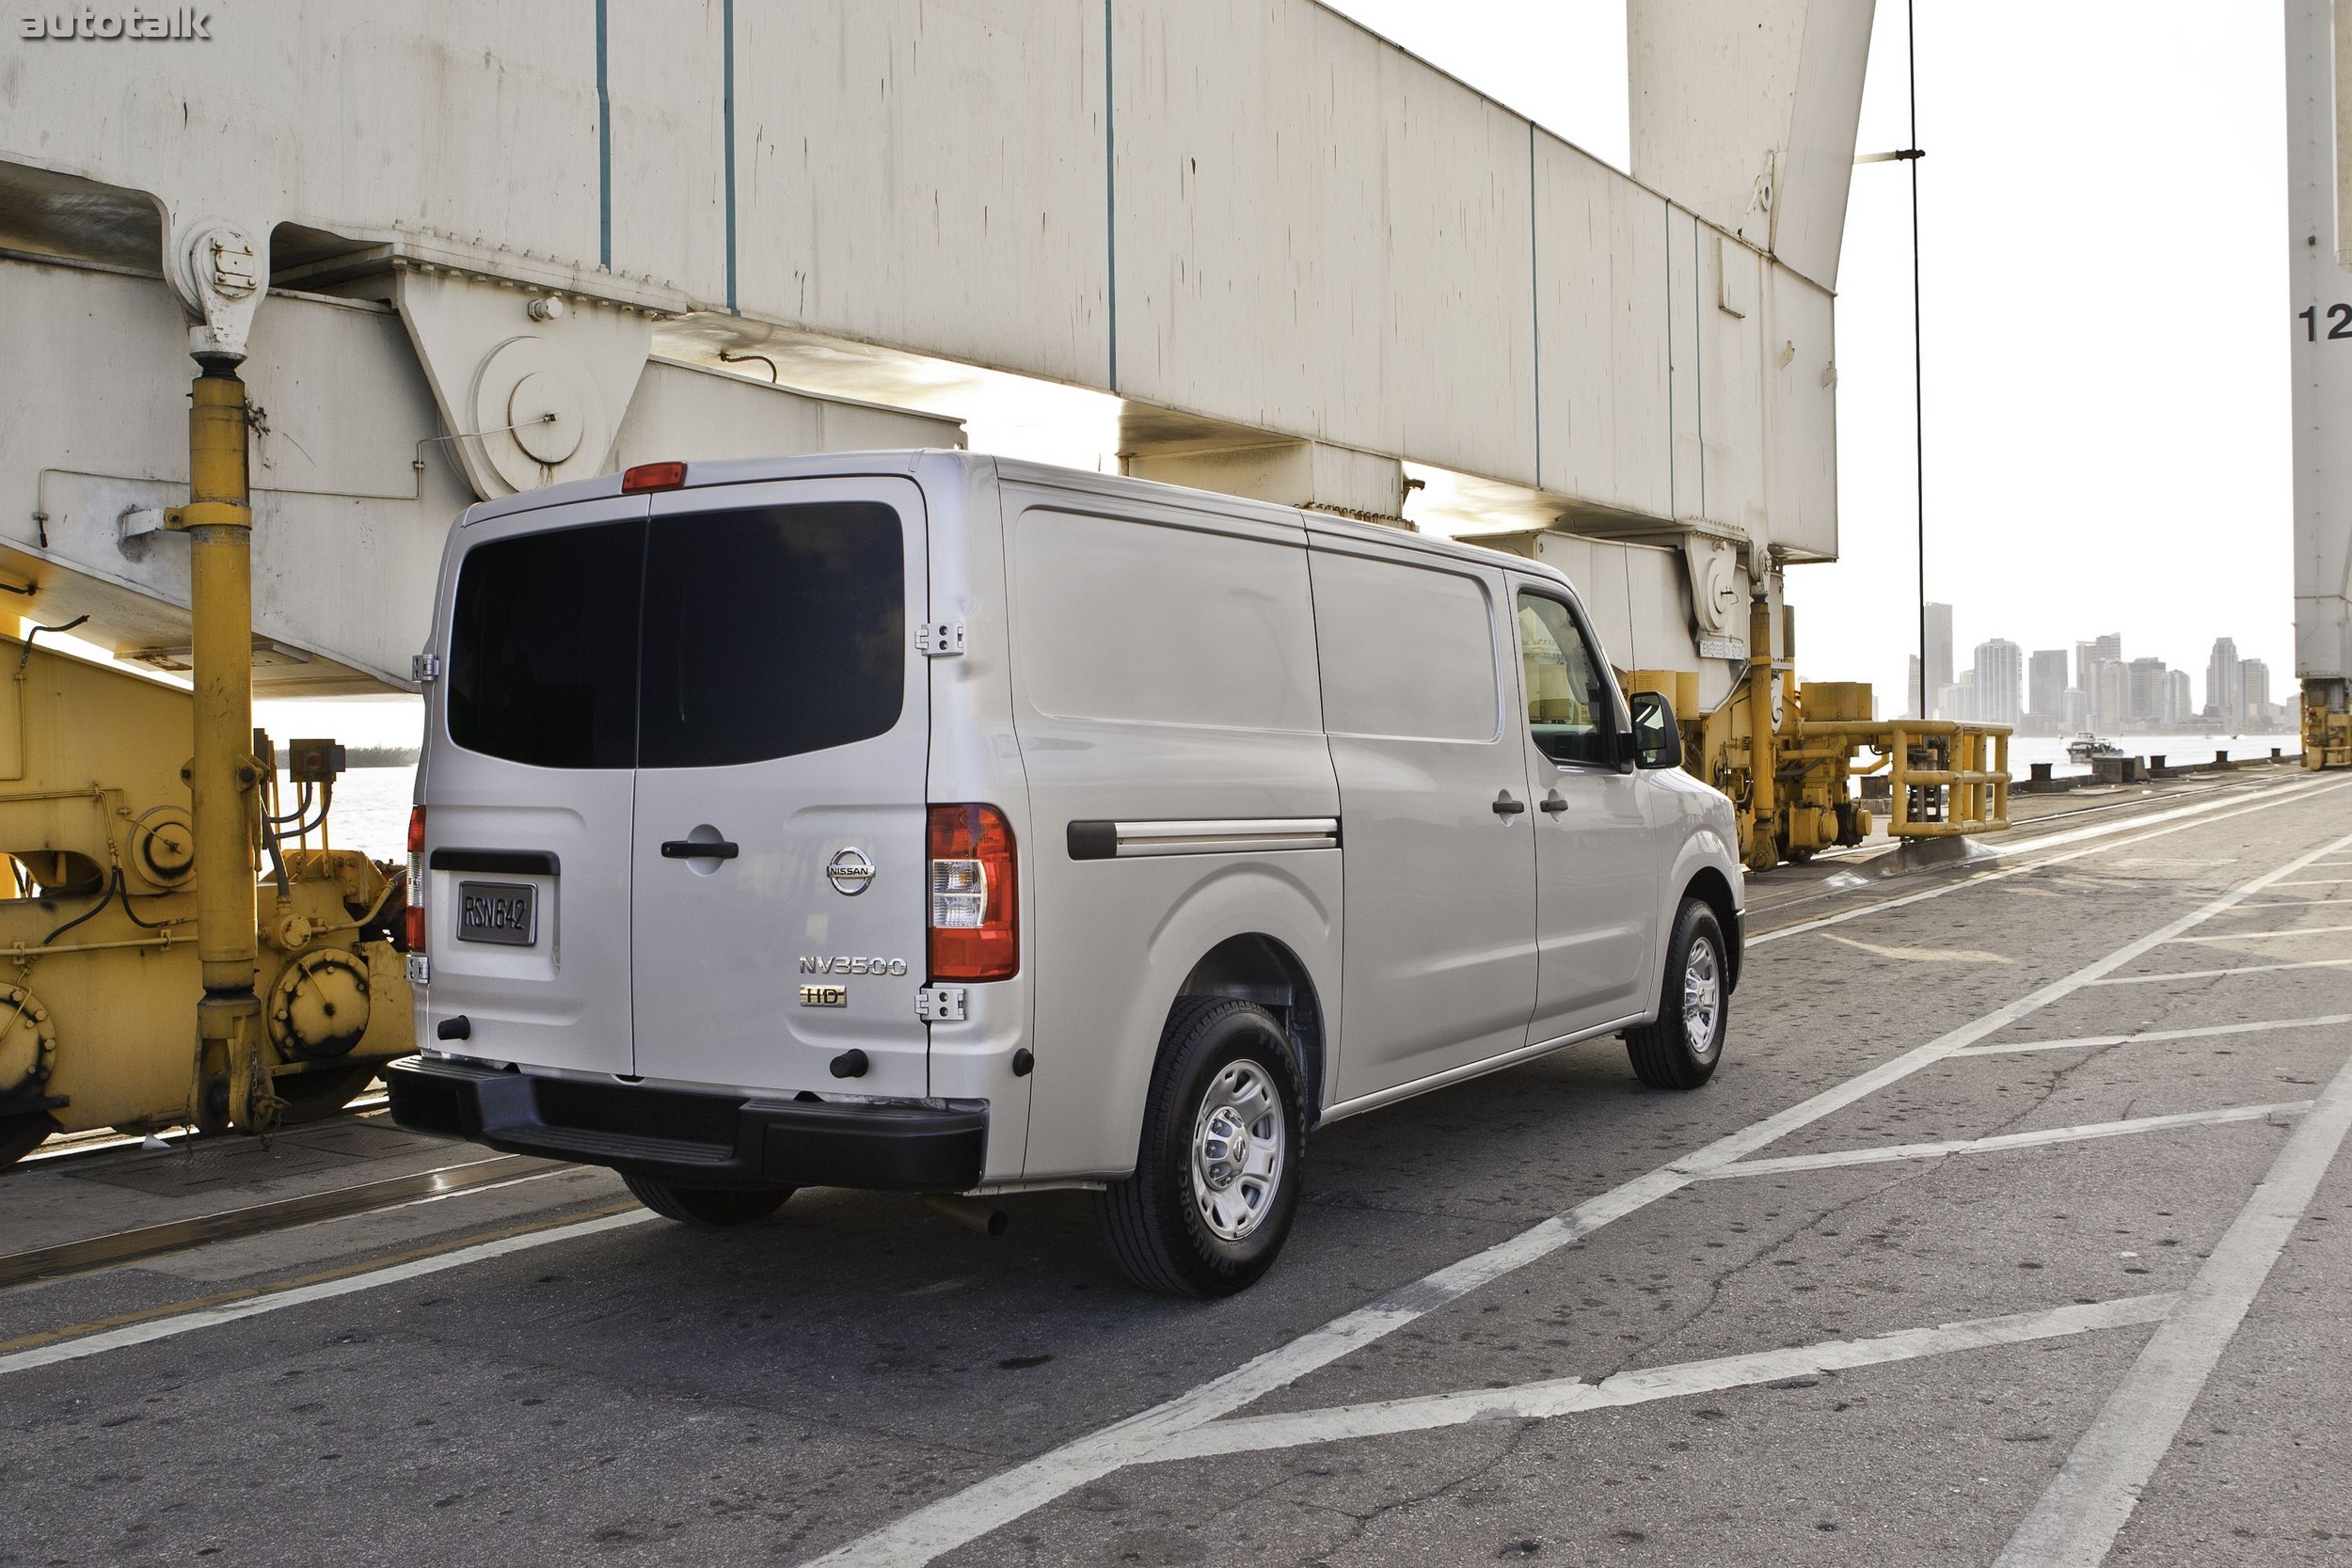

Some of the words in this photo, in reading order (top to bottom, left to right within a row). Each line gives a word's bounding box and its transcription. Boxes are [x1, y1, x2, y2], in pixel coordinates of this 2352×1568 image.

[2298, 303, 2352, 342] 12
[830, 867, 868, 876] NISSAN
[465, 895, 526, 930] RSN642
[800, 956, 907, 976] NV3500
[806, 989, 838, 1005] HD
